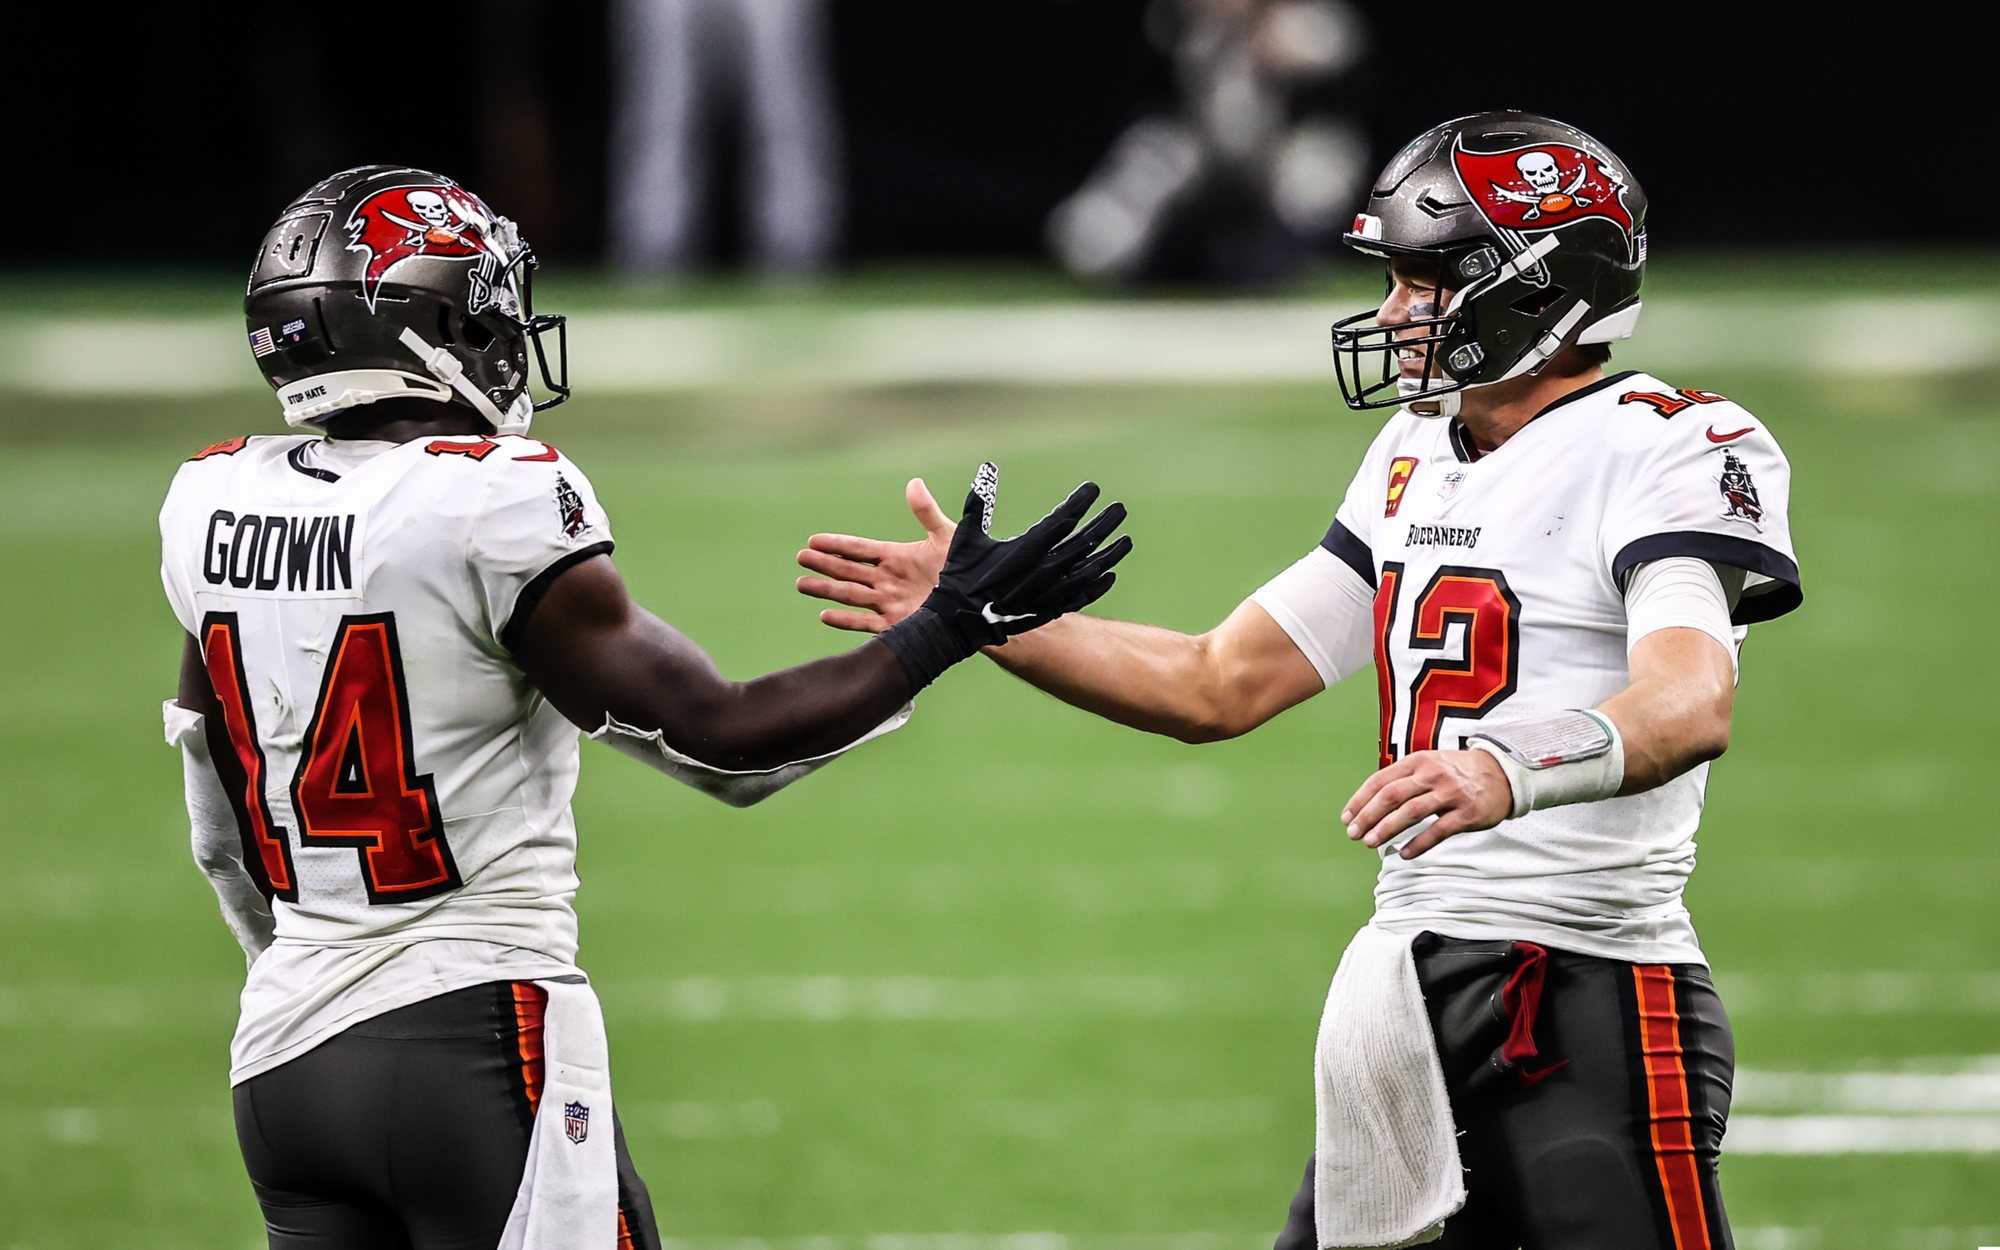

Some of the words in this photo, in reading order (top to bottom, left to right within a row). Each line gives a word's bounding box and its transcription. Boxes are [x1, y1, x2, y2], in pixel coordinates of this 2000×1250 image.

[304, 385, 327, 400] HATE
[203, 509, 355, 591] GODWIN
[1405, 524, 1481, 549] BUCCANEERS
[1373, 560, 1522, 770] 12
[200, 611, 464, 905] 14
[566, 1118, 587, 1140] NFL
